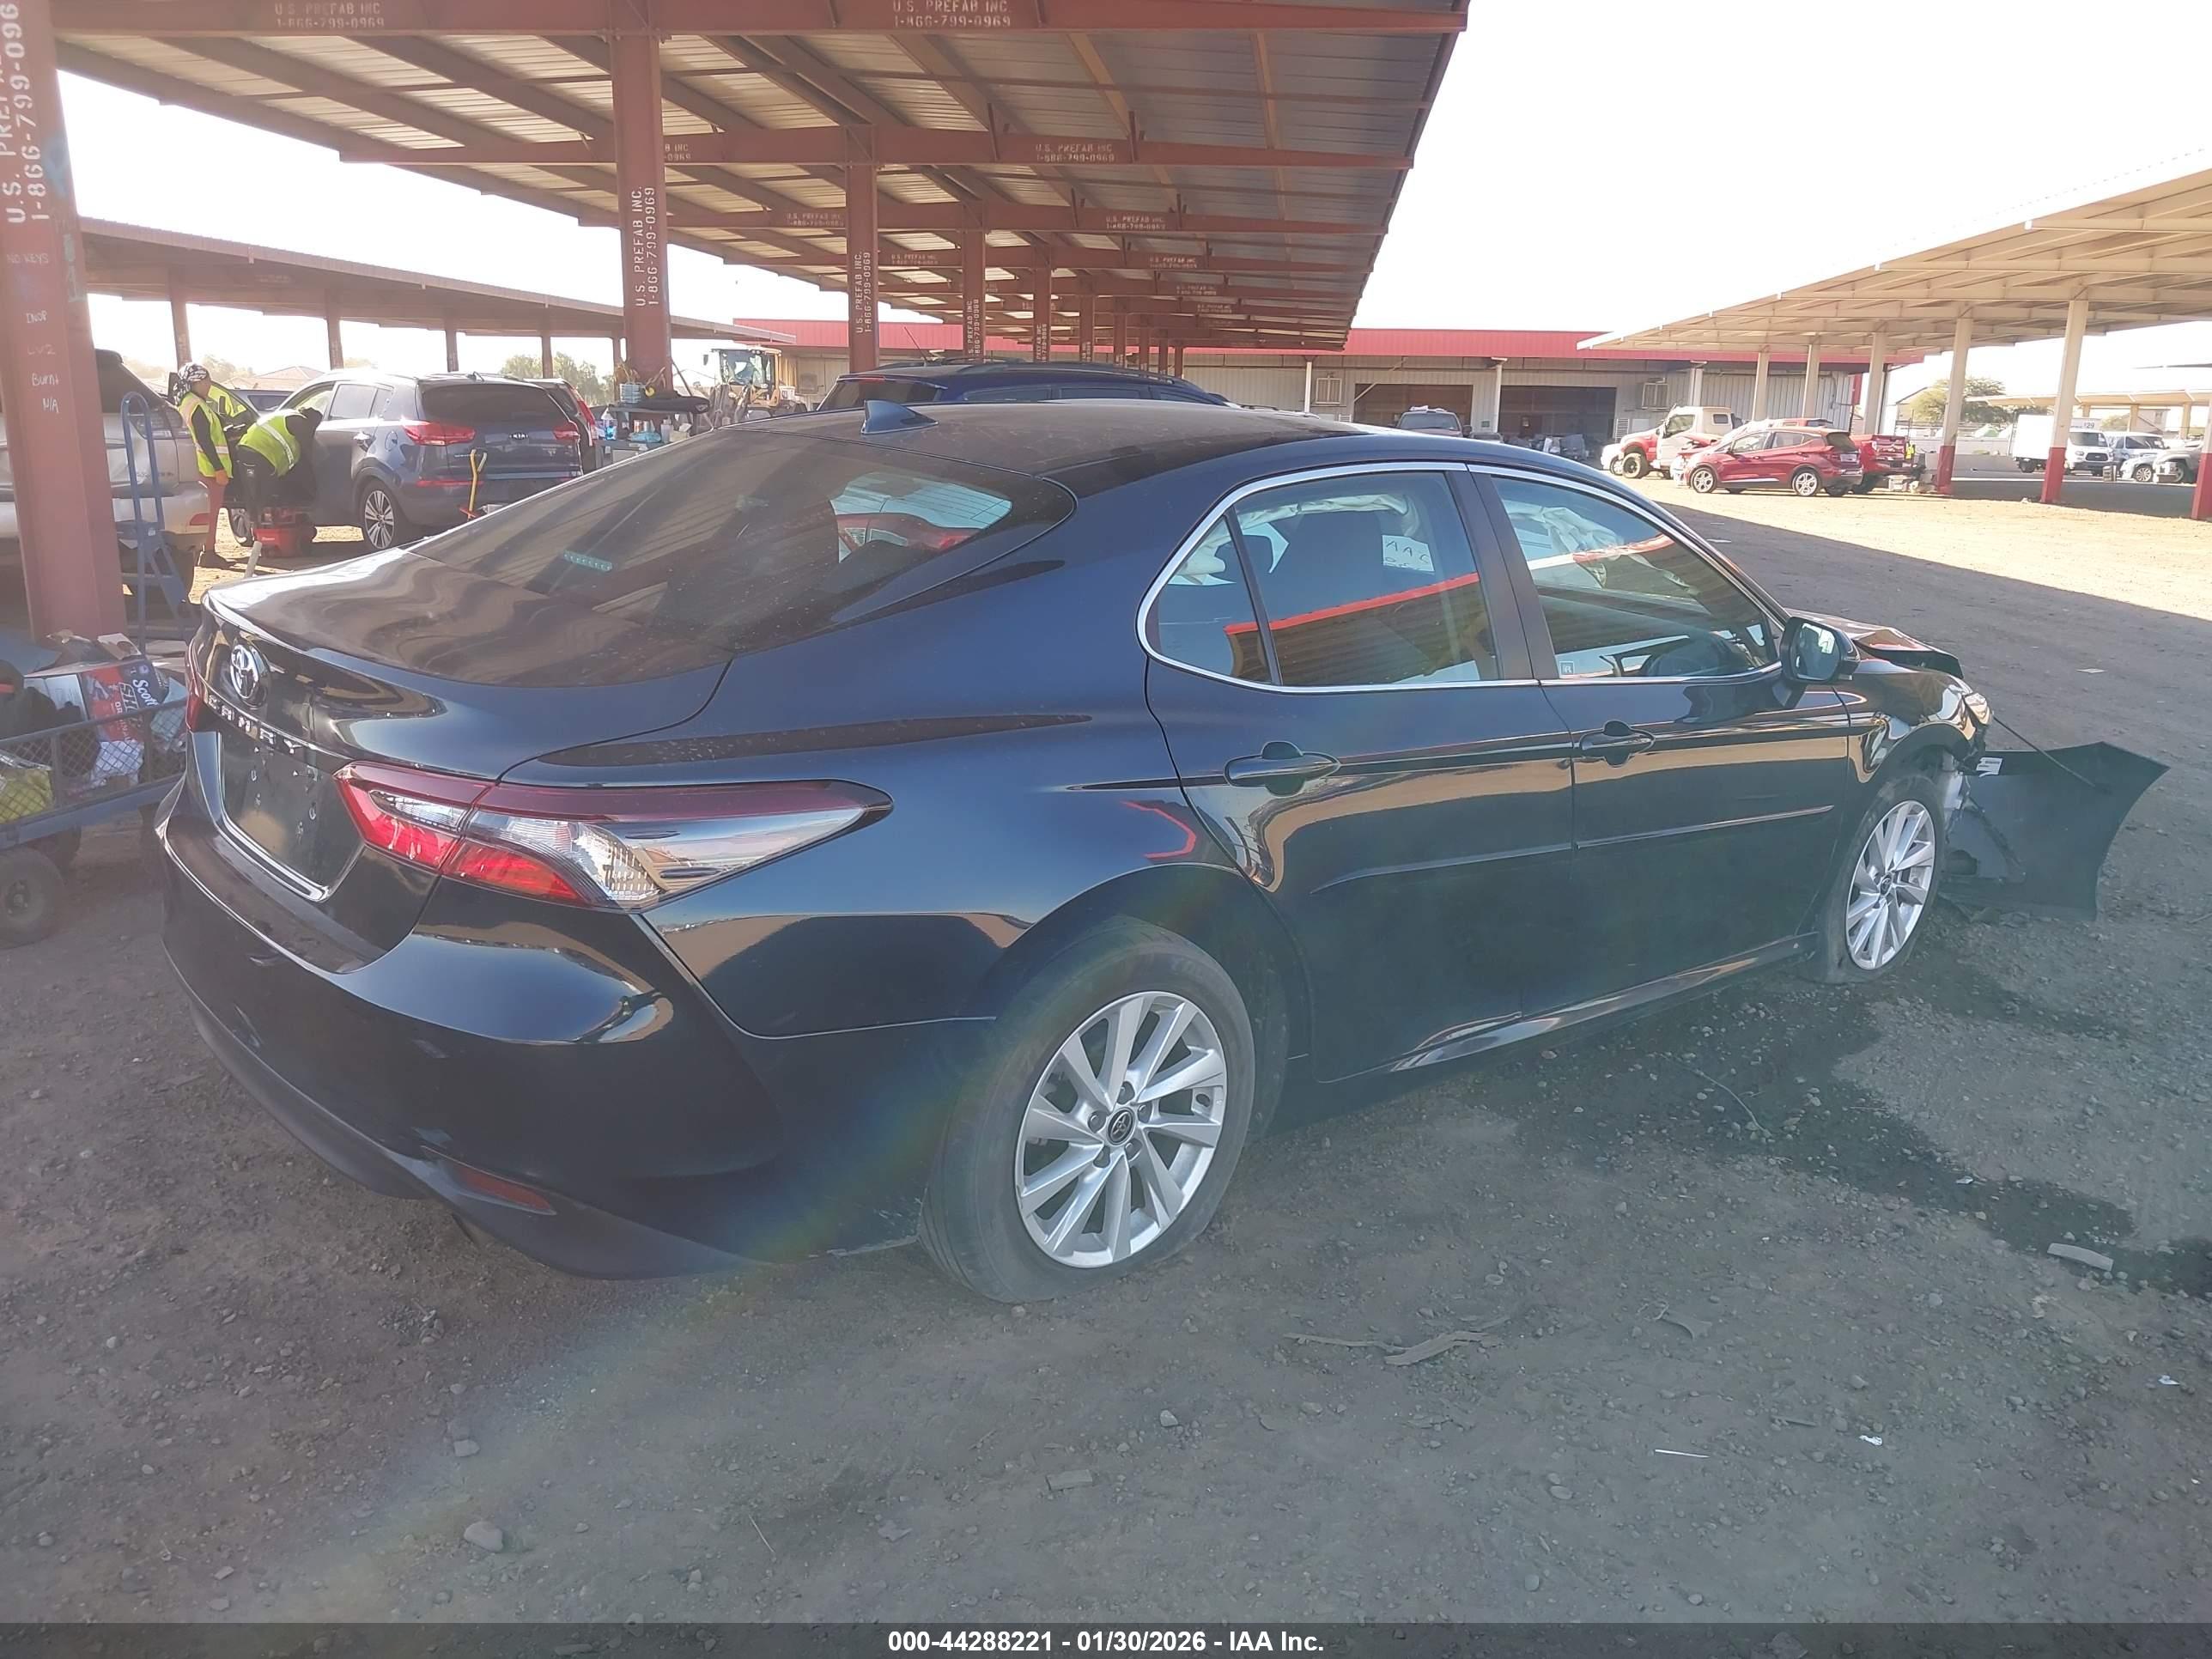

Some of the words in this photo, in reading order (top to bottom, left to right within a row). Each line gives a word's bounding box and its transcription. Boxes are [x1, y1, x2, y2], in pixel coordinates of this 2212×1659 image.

[895, 15, 1011, 27] 1-866-799-0969
[926, 0, 979, 13] PREFAB
[3, 173, 26, 223] U.S.
[631, 186, 643, 212] INC.
[23, 252, 49, 264] KEYS
[633, 219, 645, 273] PREFAB
[644, 187, 659, 305] 1-866-799-0969
[635, 281, 647, 307] U.S.
[854, 274, 863, 310] PREFAB
[863, 252, 872, 332] 1-866-799-0969
[132, 679, 159, 706] Scott
[208, 695, 301, 754] CAMRY
